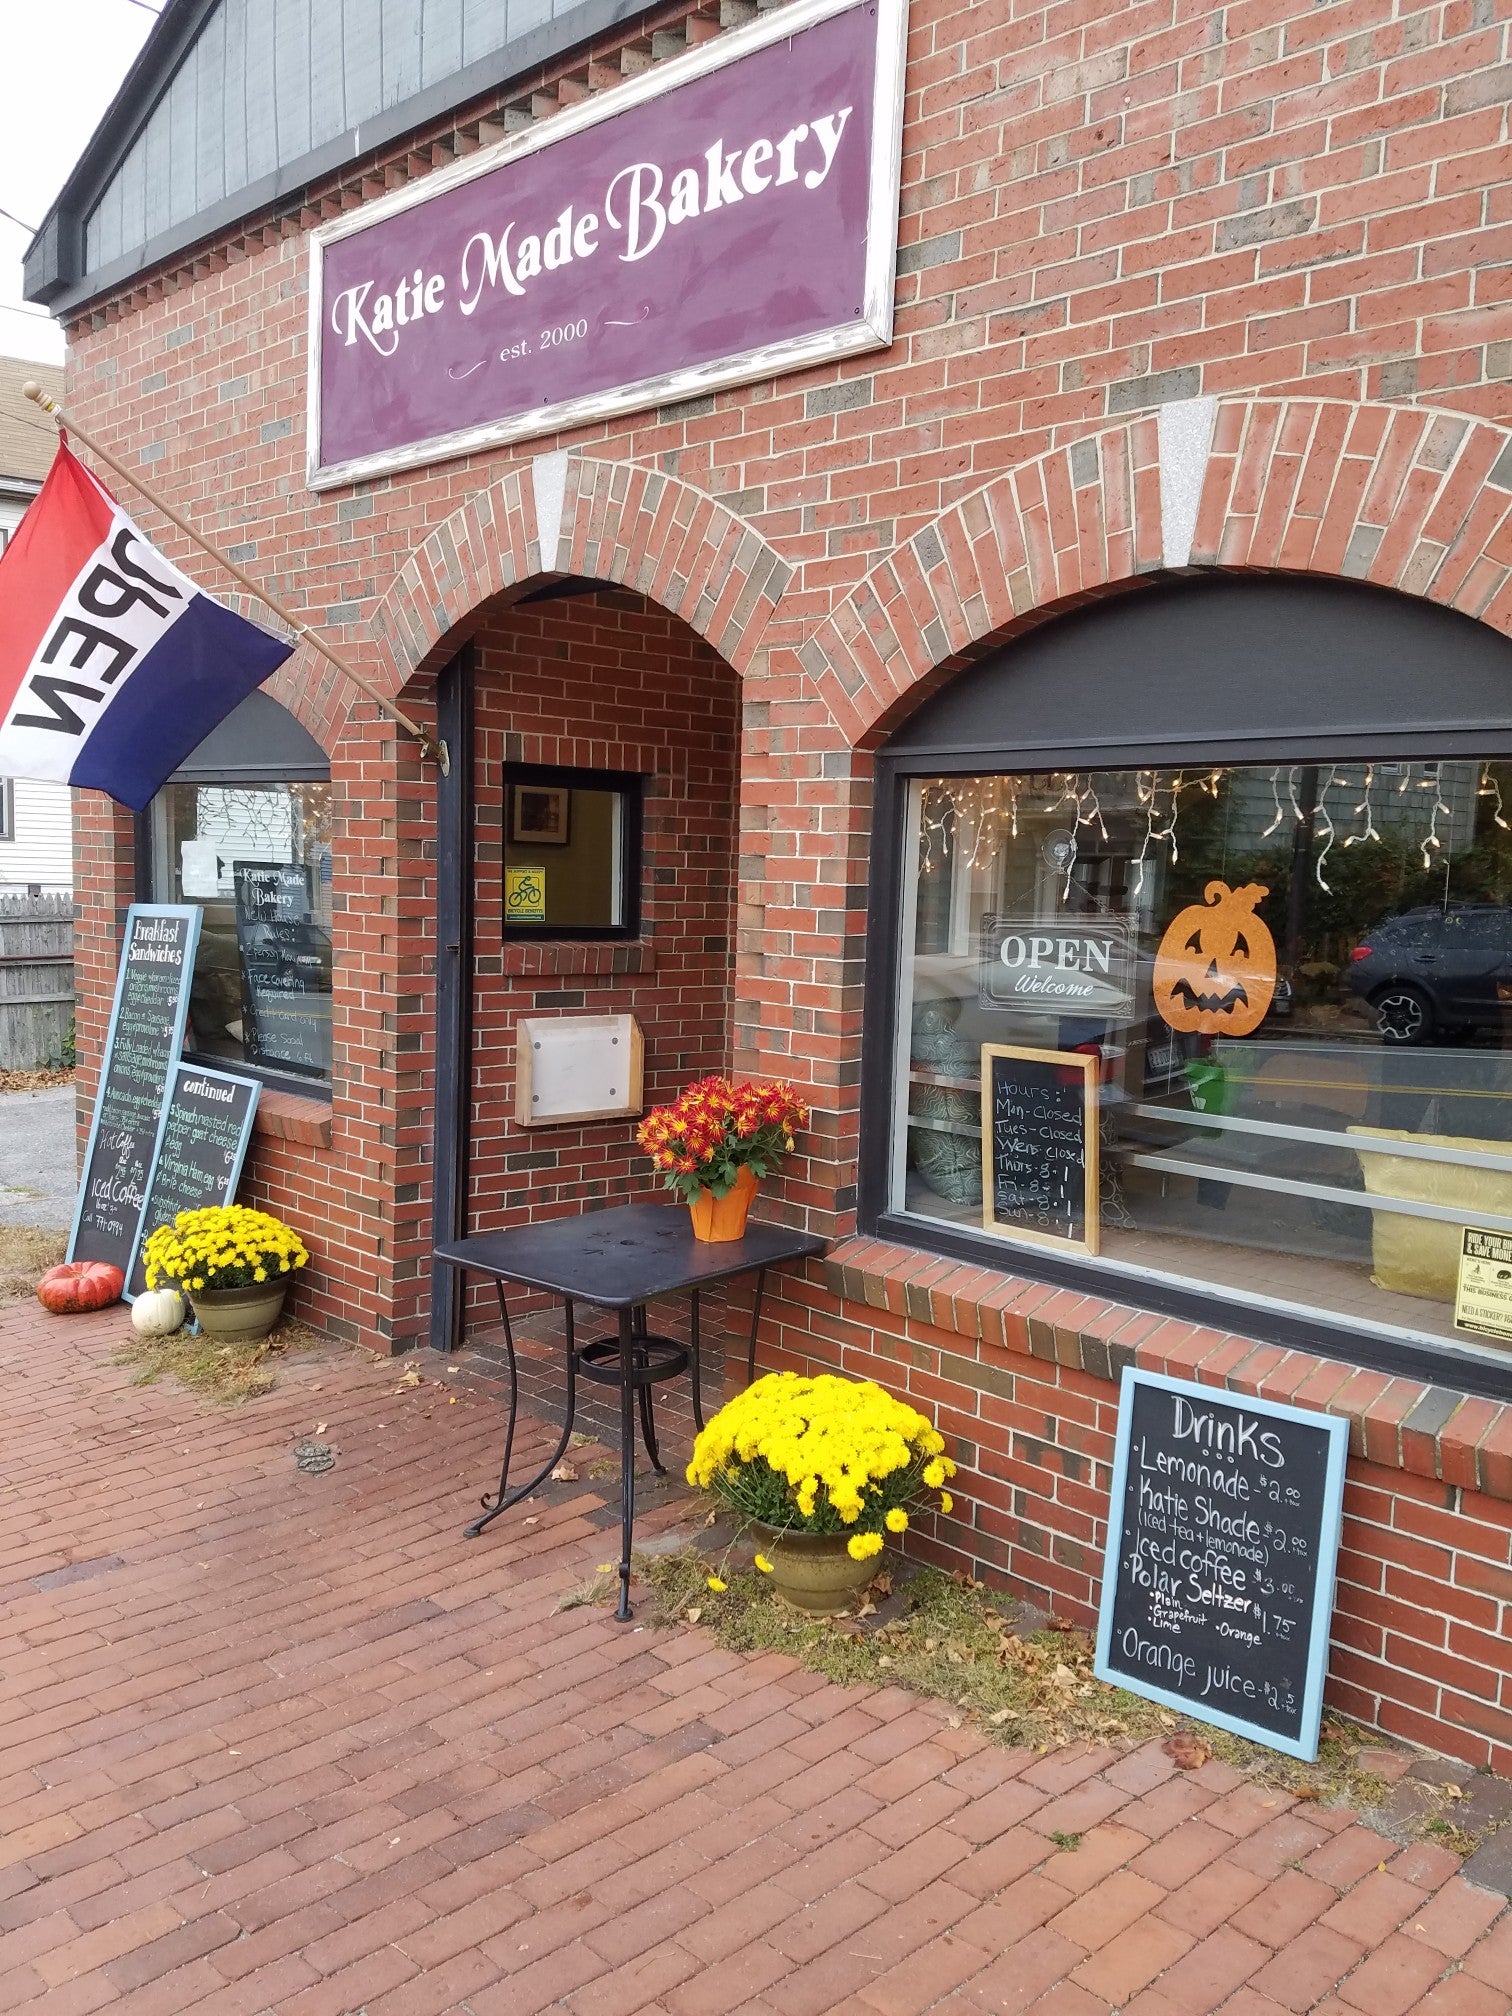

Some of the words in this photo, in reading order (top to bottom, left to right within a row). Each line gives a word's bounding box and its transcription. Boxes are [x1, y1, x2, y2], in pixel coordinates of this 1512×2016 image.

[332, 270, 445, 357] Katie
[459, 204, 599, 316] Made
[605, 106, 854, 262] Bakery
[500, 343, 533, 363] est.
[540, 318, 588, 351] 2000
[240, 868, 271, 888] Katie
[273, 869, 305, 886] Made
[252, 888, 294, 907] Bakery
[133, 919, 180, 943] Breakfast
[129, 942, 182, 966] Sandwiches
[1000, 936, 1114, 975] OPEN
[1015, 974, 1094, 998] Welcome
[183, 1077, 236, 1103] continued
[199, 1111, 227, 1133] roasted
[227, 1118, 244, 1137] red
[100, 1128, 117, 1150] Hot
[170, 1138, 183, 1159] egg
[191, 1128, 209, 1144] goat
[208, 1131, 238, 1150] cheese
[163, 1154, 189, 1177] Virginia
[203, 1172, 215, 1192] egg
[91, 1175, 113, 1200] Iced
[112, 1180, 145, 1211] Coffee
[161, 1173, 178, 1190] Brie
[178, 1180, 203, 1199] cheese
[1467, 1232, 1483, 1245] RIDE
[1484, 1235, 1502, 1248] YOUR
[1474, 1244, 1491, 1258] SAVE
[1463, 1285, 1476, 1294] THIS
[1478, 1289, 1507, 1301] BUSINESS
[1462, 1305, 1475, 1315] NEED
[1475, 1307, 1479, 1316] A
[1140, 1474, 1189, 1521] Katie
[1195, 1495, 1261, 1544] Shade
[1169, 1518, 1194, 1543] tea
[1136, 1527, 1176, 1567] Iced
[1180, 1549, 1246, 1591] coffee
[1129, 1553, 1182, 1597] Polar
[1186, 1573, 1253, 1613] Seltzer
[1155, 1591, 1183, 1610] Plain
[1153, 1605, 1207, 1626] Grapefruit
[1152, 1618, 1182, 1634] Lime
[1220, 1622, 1262, 1648] Orange
[1122, 1627, 1196, 1687] Orange
